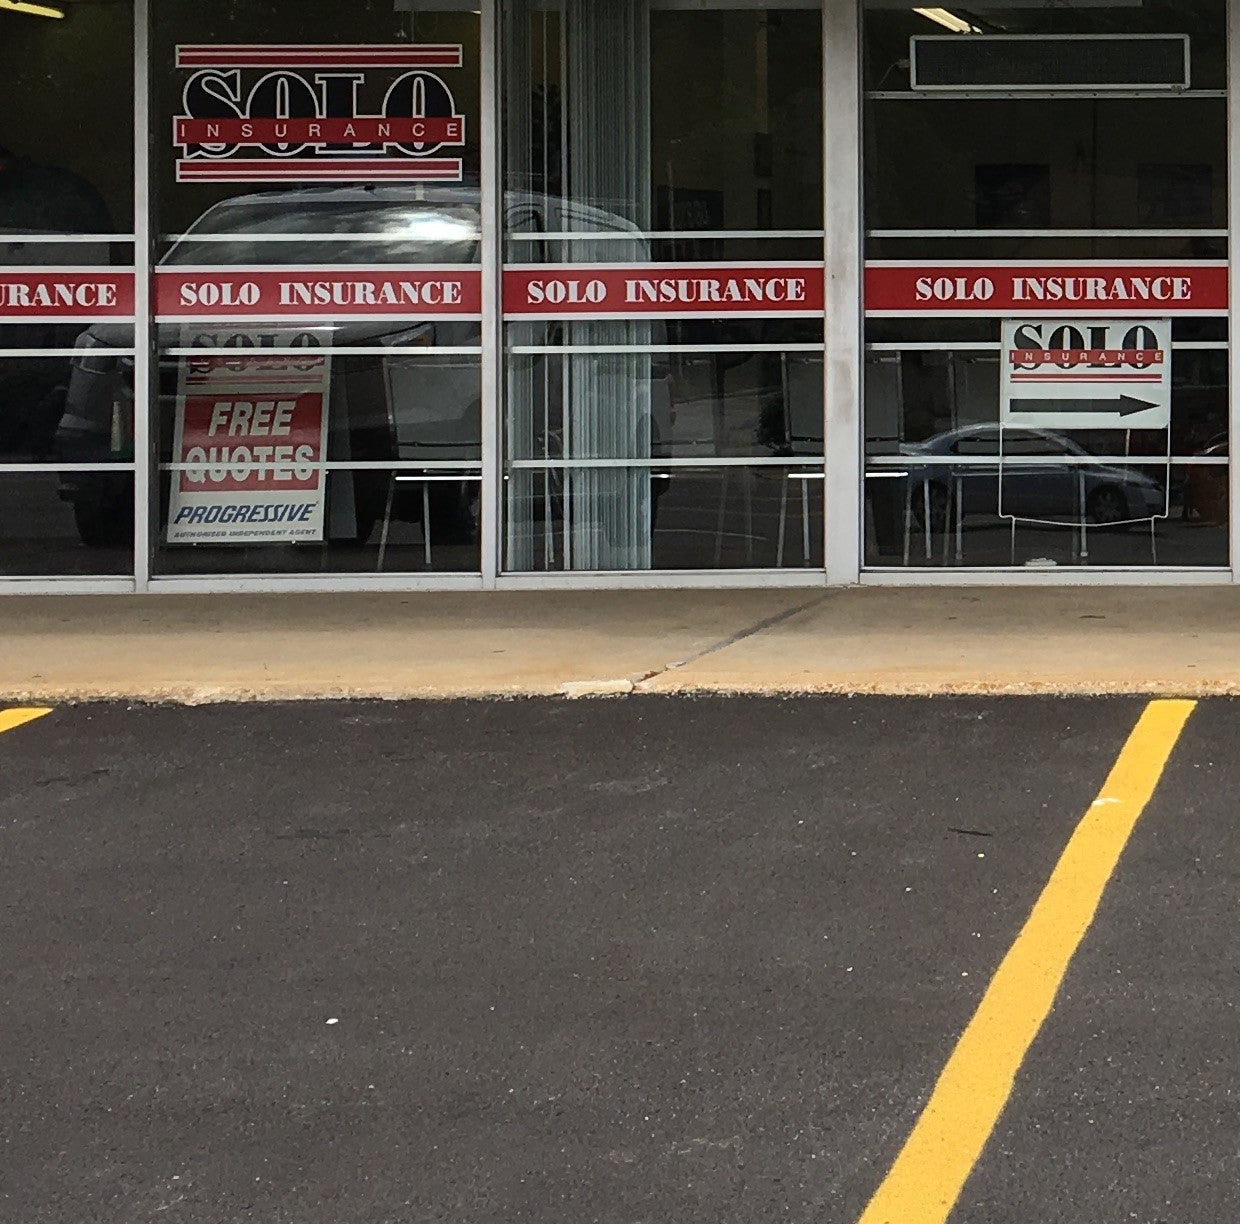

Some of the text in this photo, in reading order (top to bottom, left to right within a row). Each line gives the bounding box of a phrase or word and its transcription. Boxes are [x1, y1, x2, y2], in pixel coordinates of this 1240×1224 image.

[182, 69, 456, 158] SOLO
[180, 122, 459, 138] INSURANCE
[180, 281, 462, 306] SOLO INSURANCE
[527, 278, 806, 304] SOLO INSURANCE
[915, 276, 1191, 301] SOLO INSURANCE
[1010, 351, 1162, 362] INSURANCE
[1013, 324, 1159, 371] SOLO
[208, 400, 297, 437] FREE
[184, 444, 315, 484] QUOTES
[173, 503, 318, 525] PROGRESSIVE
